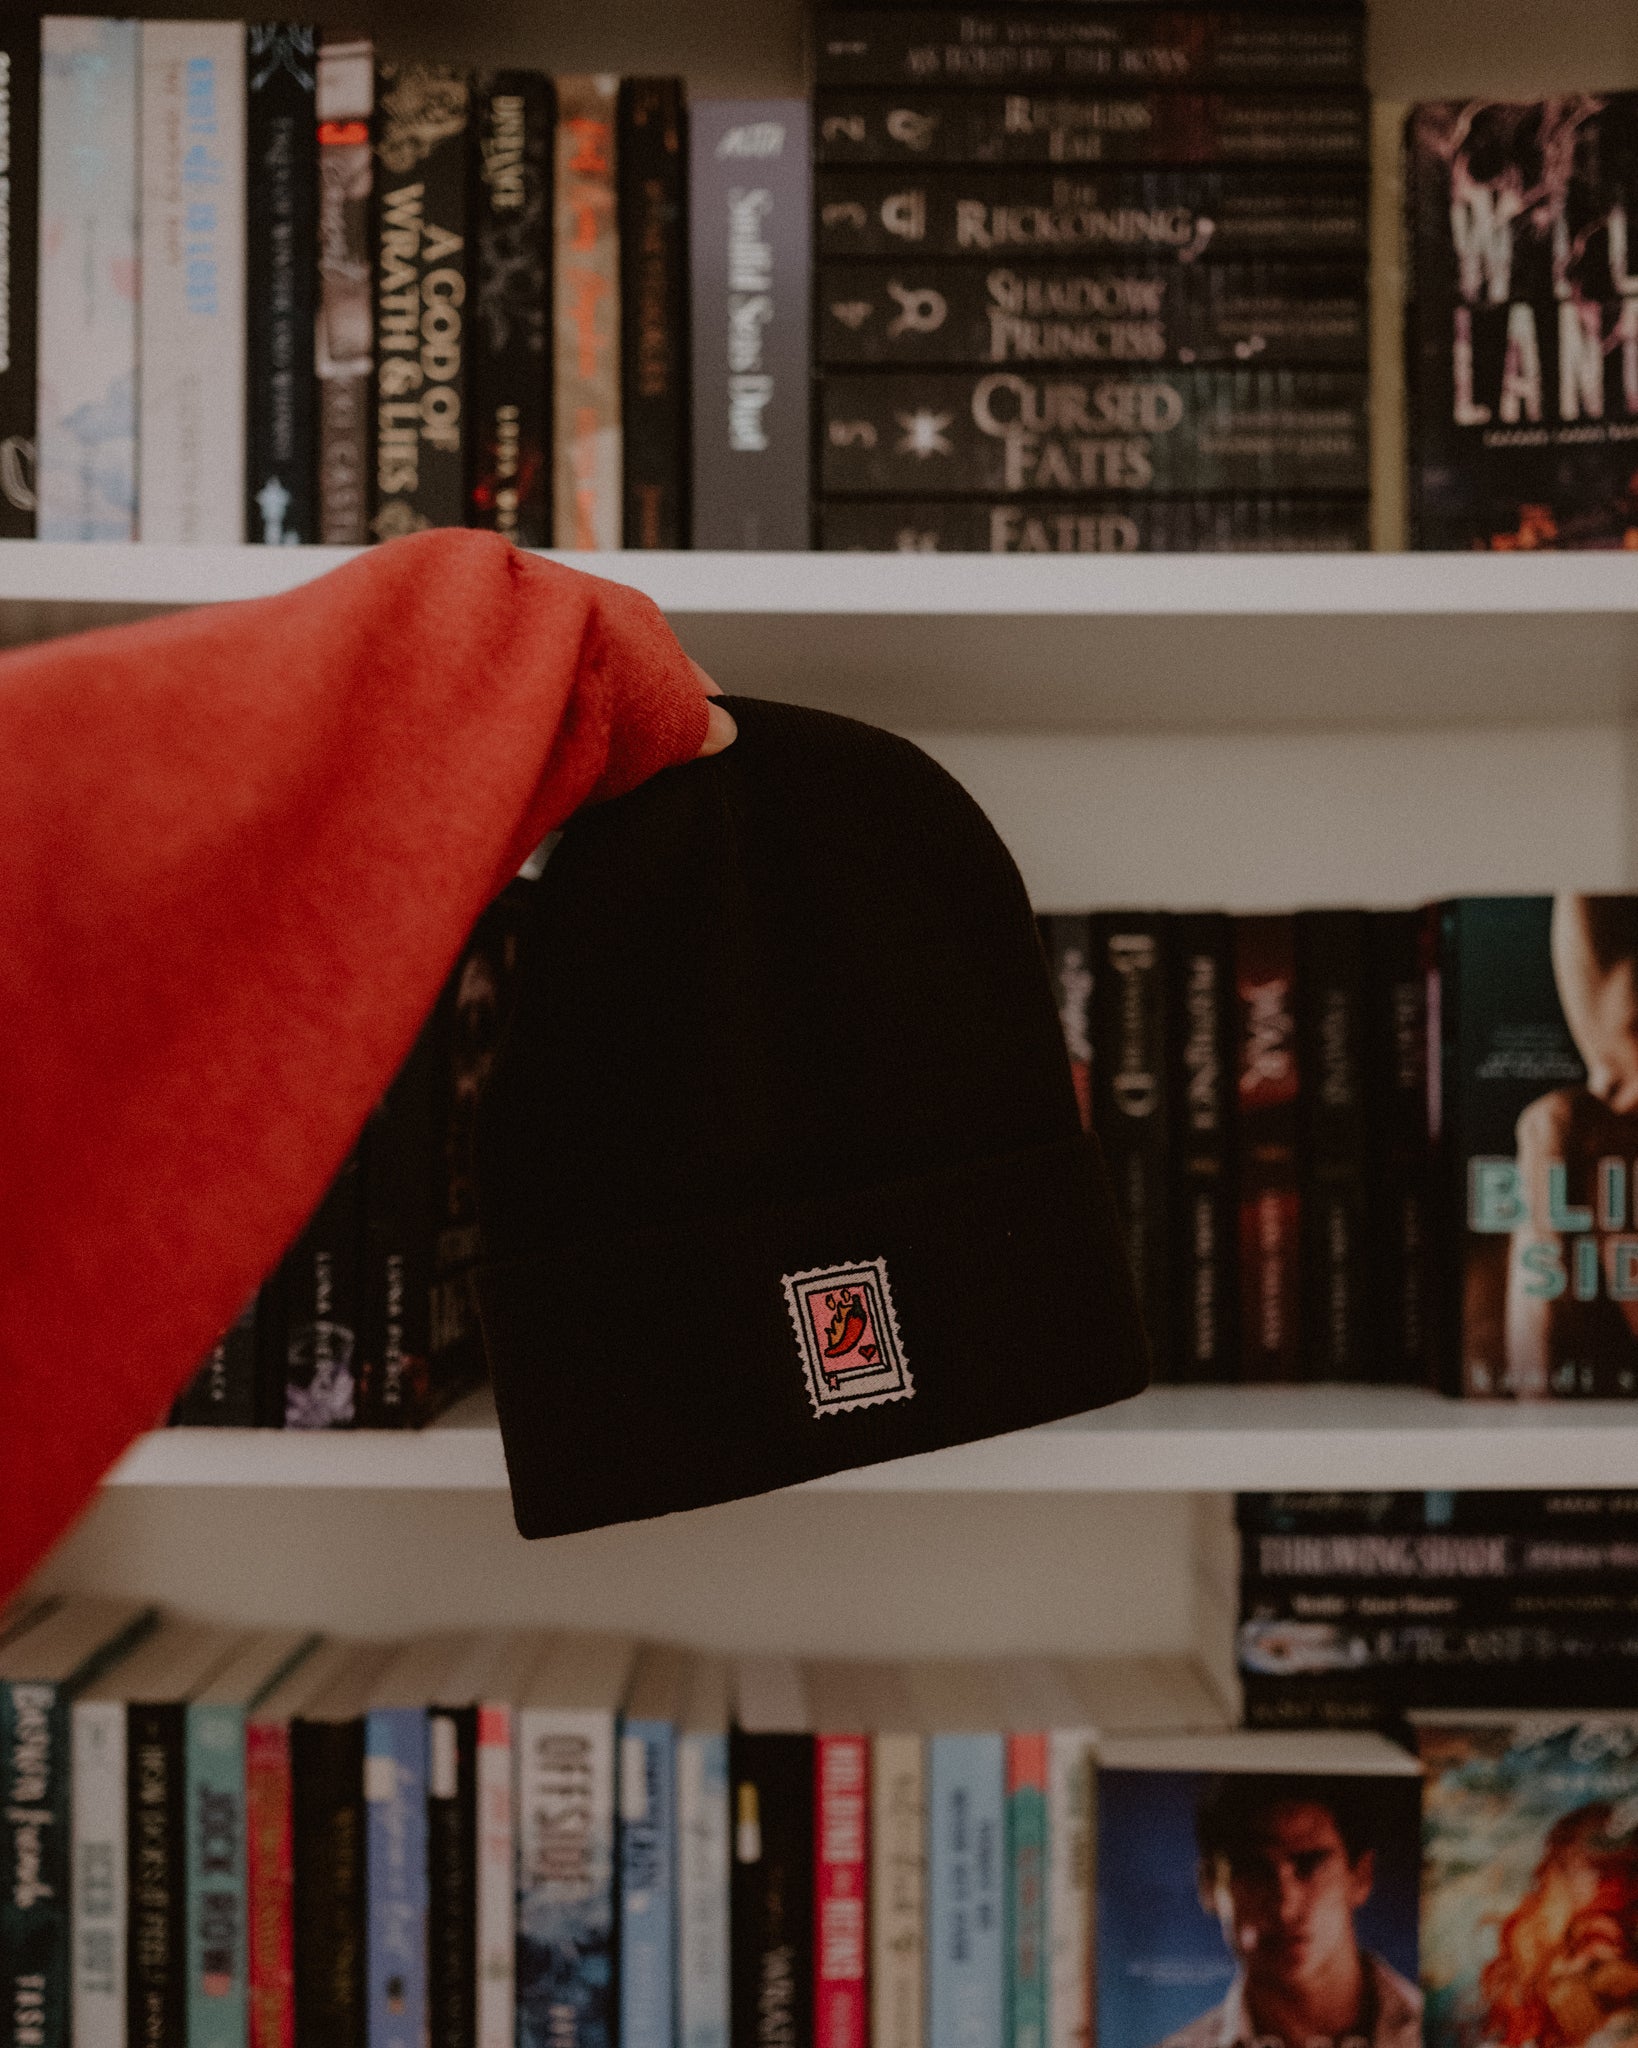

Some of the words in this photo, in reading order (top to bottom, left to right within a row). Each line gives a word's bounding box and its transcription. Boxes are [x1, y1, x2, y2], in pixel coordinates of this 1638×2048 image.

[420, 222, 465, 263] A
[955, 199, 1193, 250] RECKONING
[379, 183, 425, 351] WRATH
[420, 267, 467, 383] GOD
[378, 355, 424, 398] &
[970, 375, 1184, 439] CURSED
[377, 402, 422, 491] LIES
[420, 385, 461, 450] OF
[1003, 426, 1154, 492] FATES
[535, 1734, 593, 1885] OFFSIDE
